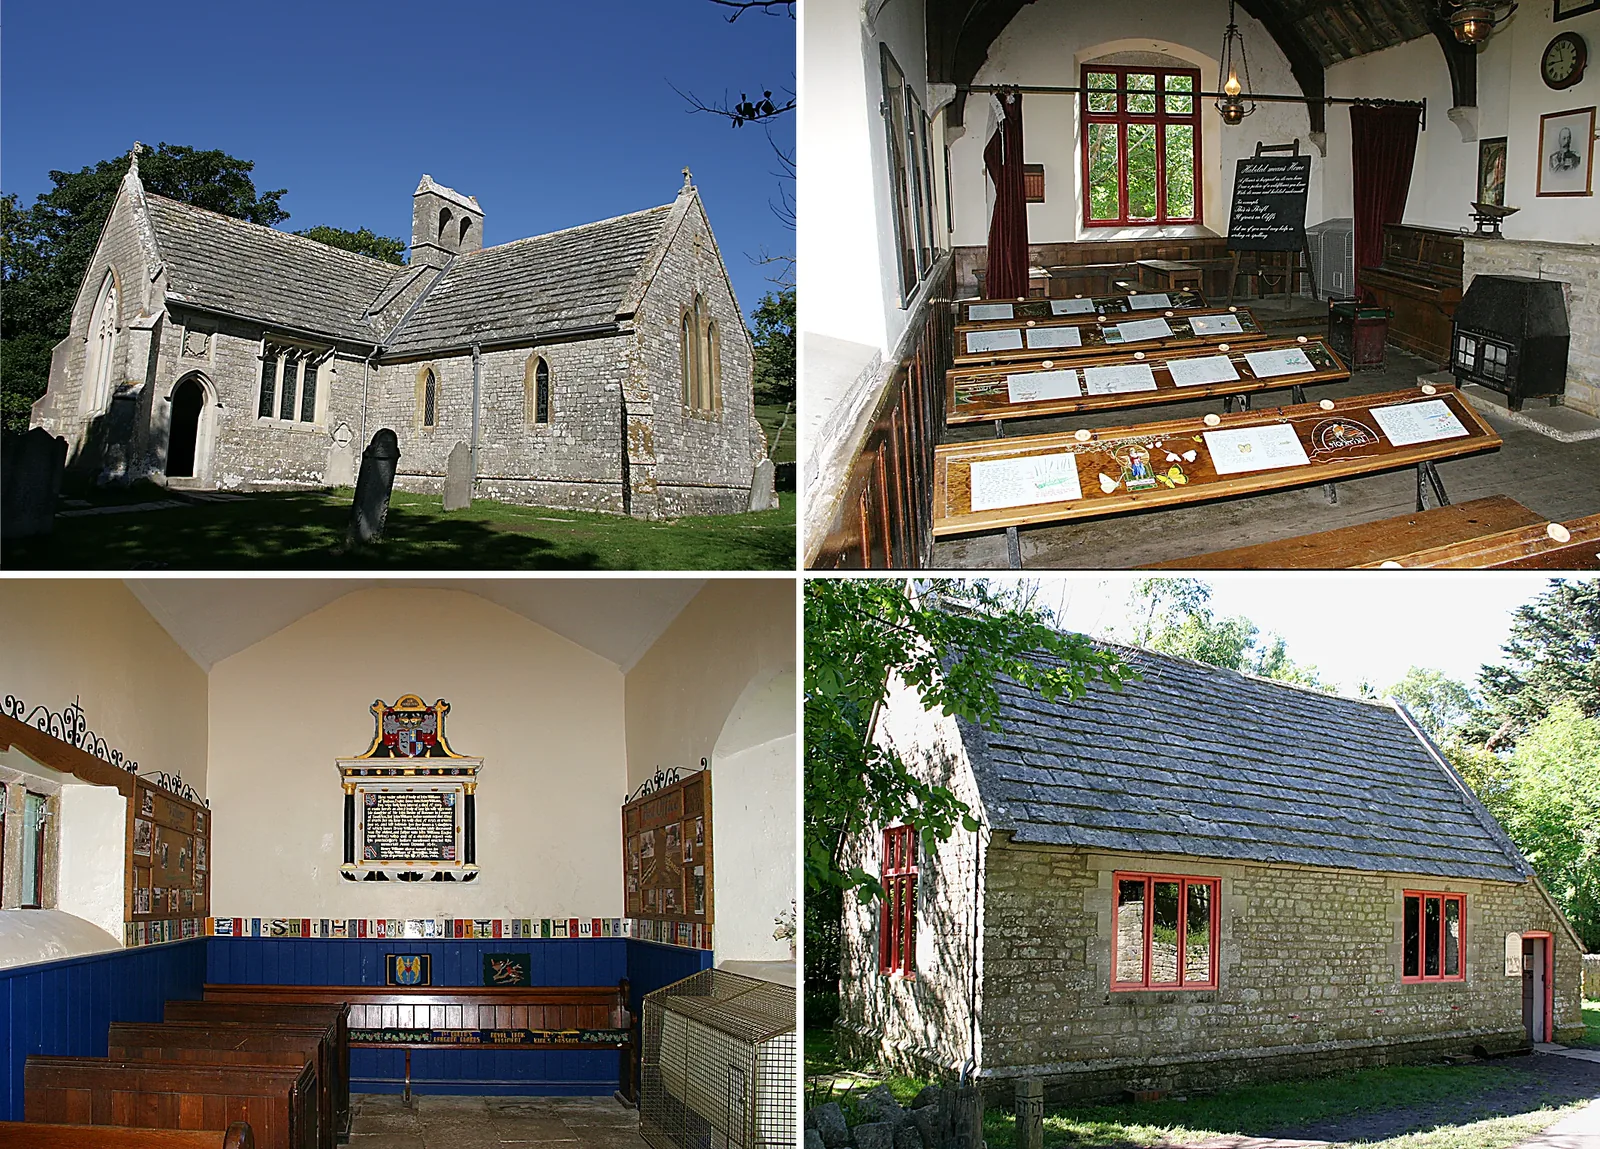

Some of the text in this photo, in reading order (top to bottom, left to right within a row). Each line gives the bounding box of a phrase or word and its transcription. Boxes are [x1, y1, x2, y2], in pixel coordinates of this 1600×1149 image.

[1241, 164, 1269, 173] Habitat
[1287, 162, 1304, 171] Home
[272, 918, 329, 936] Smith
[473, 919, 549, 937] Tizzard
[1033, 1114, 1040, 1128] 7
